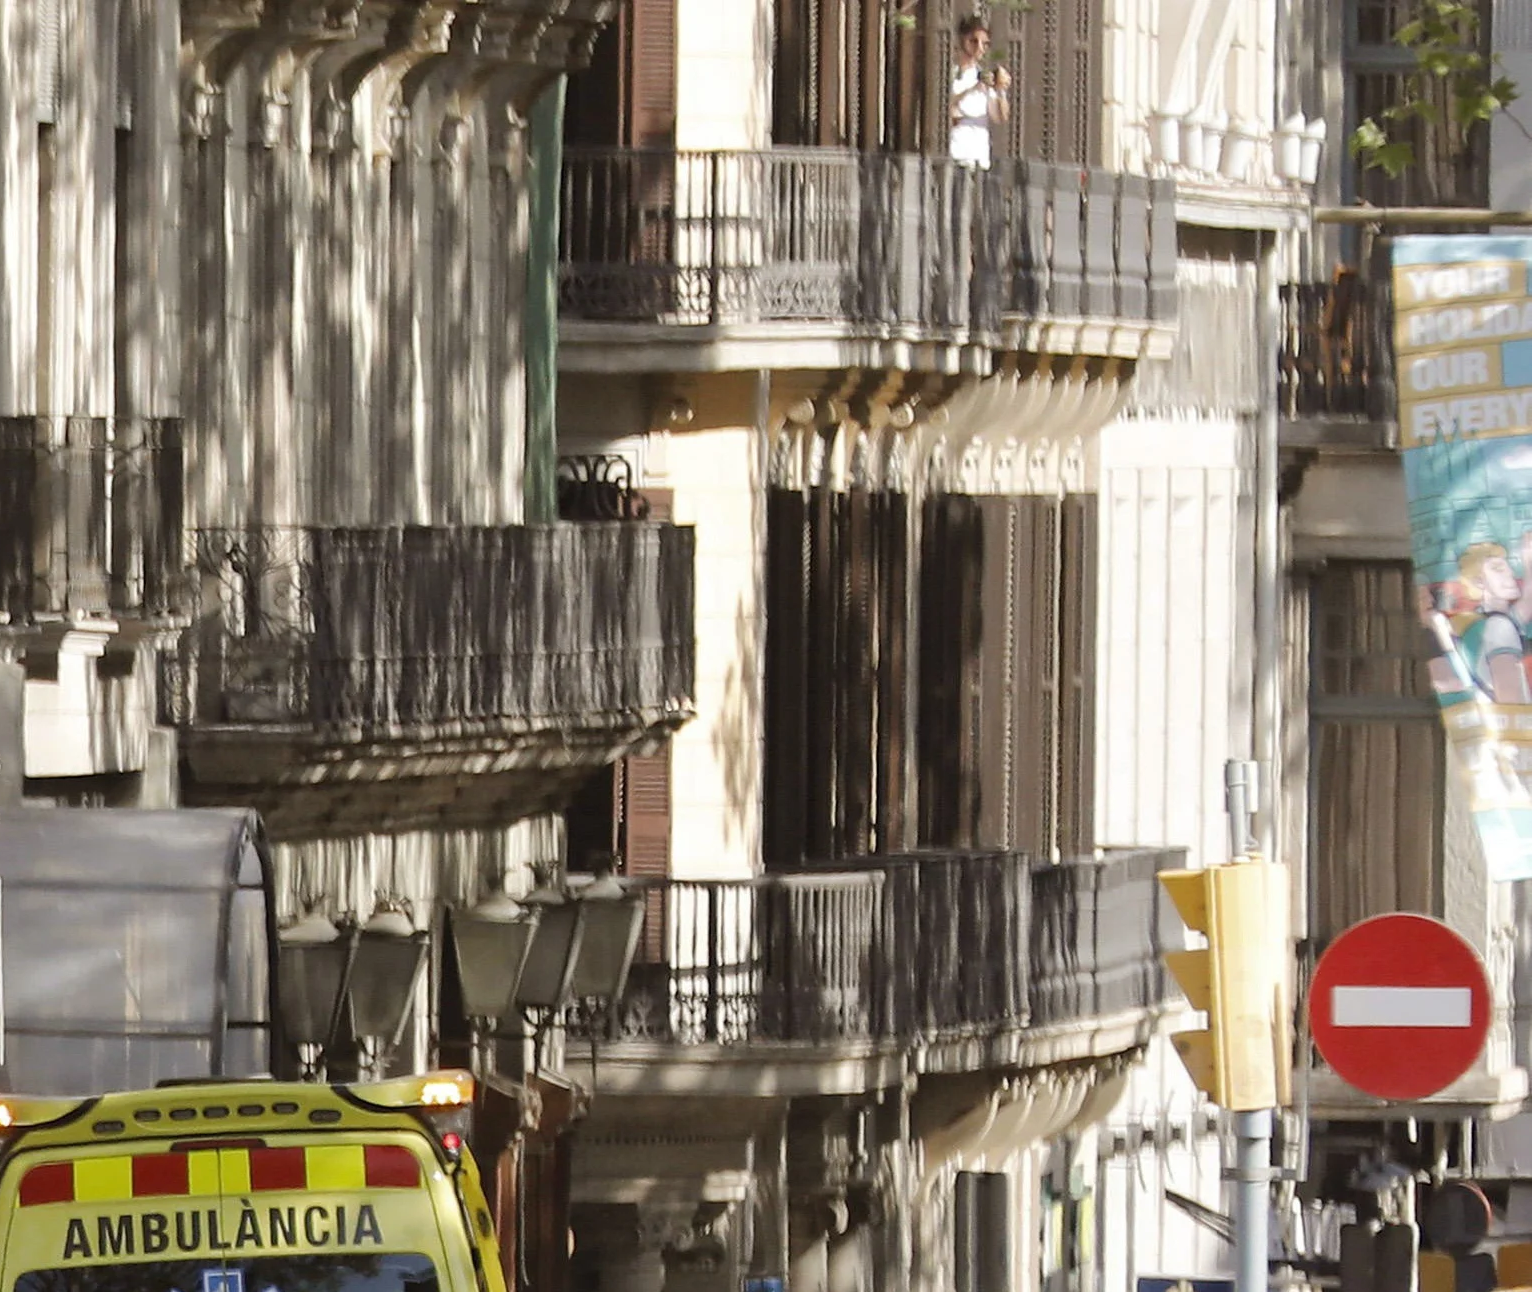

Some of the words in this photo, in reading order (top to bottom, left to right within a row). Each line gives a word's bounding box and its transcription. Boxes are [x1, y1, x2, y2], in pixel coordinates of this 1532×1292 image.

[1406, 264, 1511, 300] YOUR
[1410, 351, 1489, 391] OUR
[63, 1199, 384, 1260] AMBULÀNCIA
